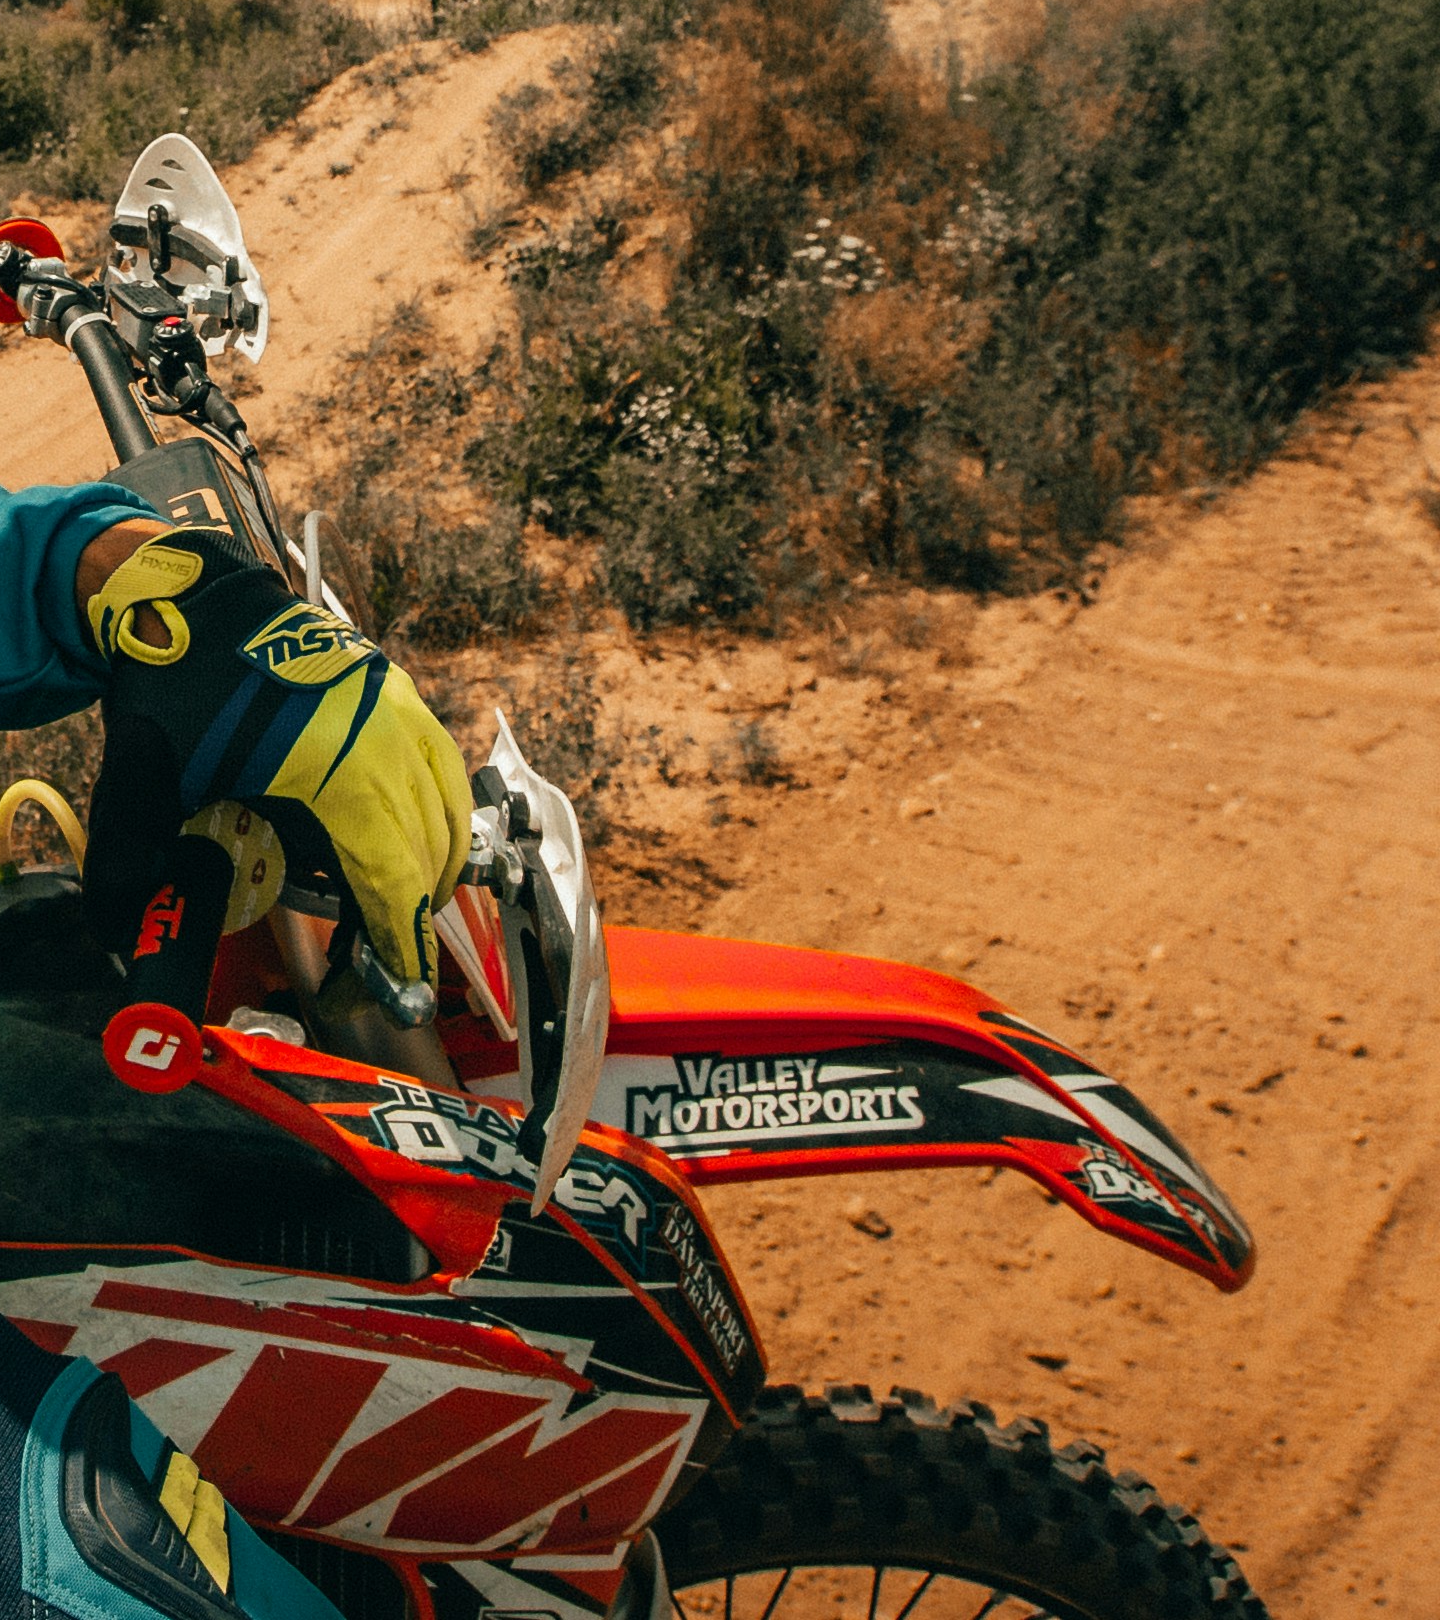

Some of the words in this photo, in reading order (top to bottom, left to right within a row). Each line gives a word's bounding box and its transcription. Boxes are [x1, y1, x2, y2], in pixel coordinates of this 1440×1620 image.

[140, 555, 192, 576] AXXIS
[681, 1057, 818, 1098] VALLEY
[377, 1075, 526, 1138] TEA
[632, 1085, 926, 1138] MOTORSPORTS
[664, 1218, 748, 1357] DAVENPORT
